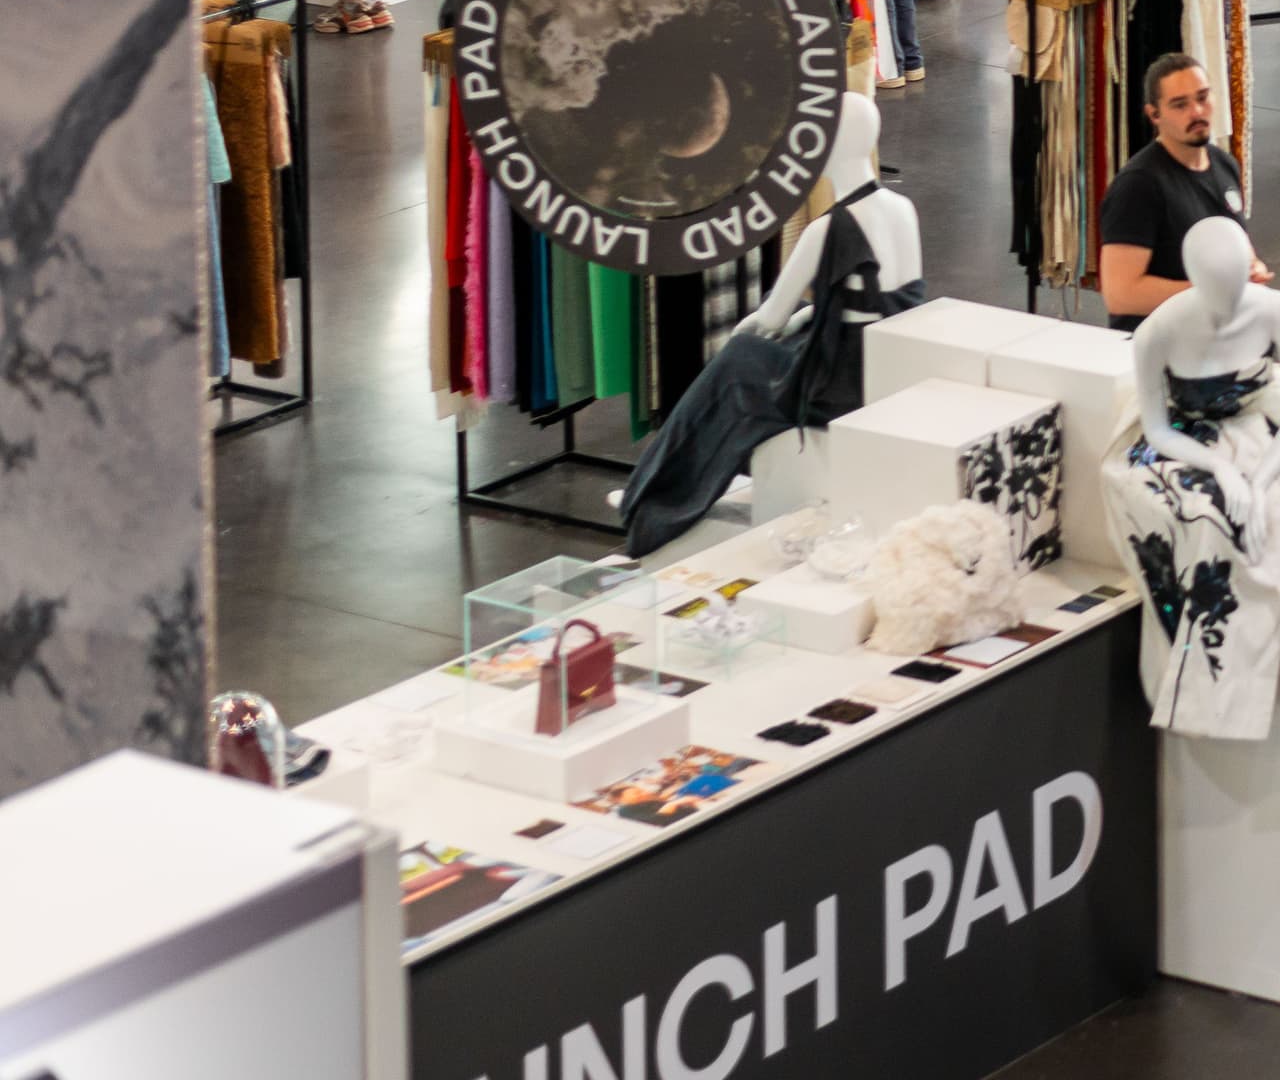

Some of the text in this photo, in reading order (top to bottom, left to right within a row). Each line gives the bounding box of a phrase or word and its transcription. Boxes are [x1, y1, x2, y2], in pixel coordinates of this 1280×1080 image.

[461, 0, 650, 265] LAUNCH PAD
[682, 191, 776, 261] PAD
[884, 770, 1103, 992] PAD
